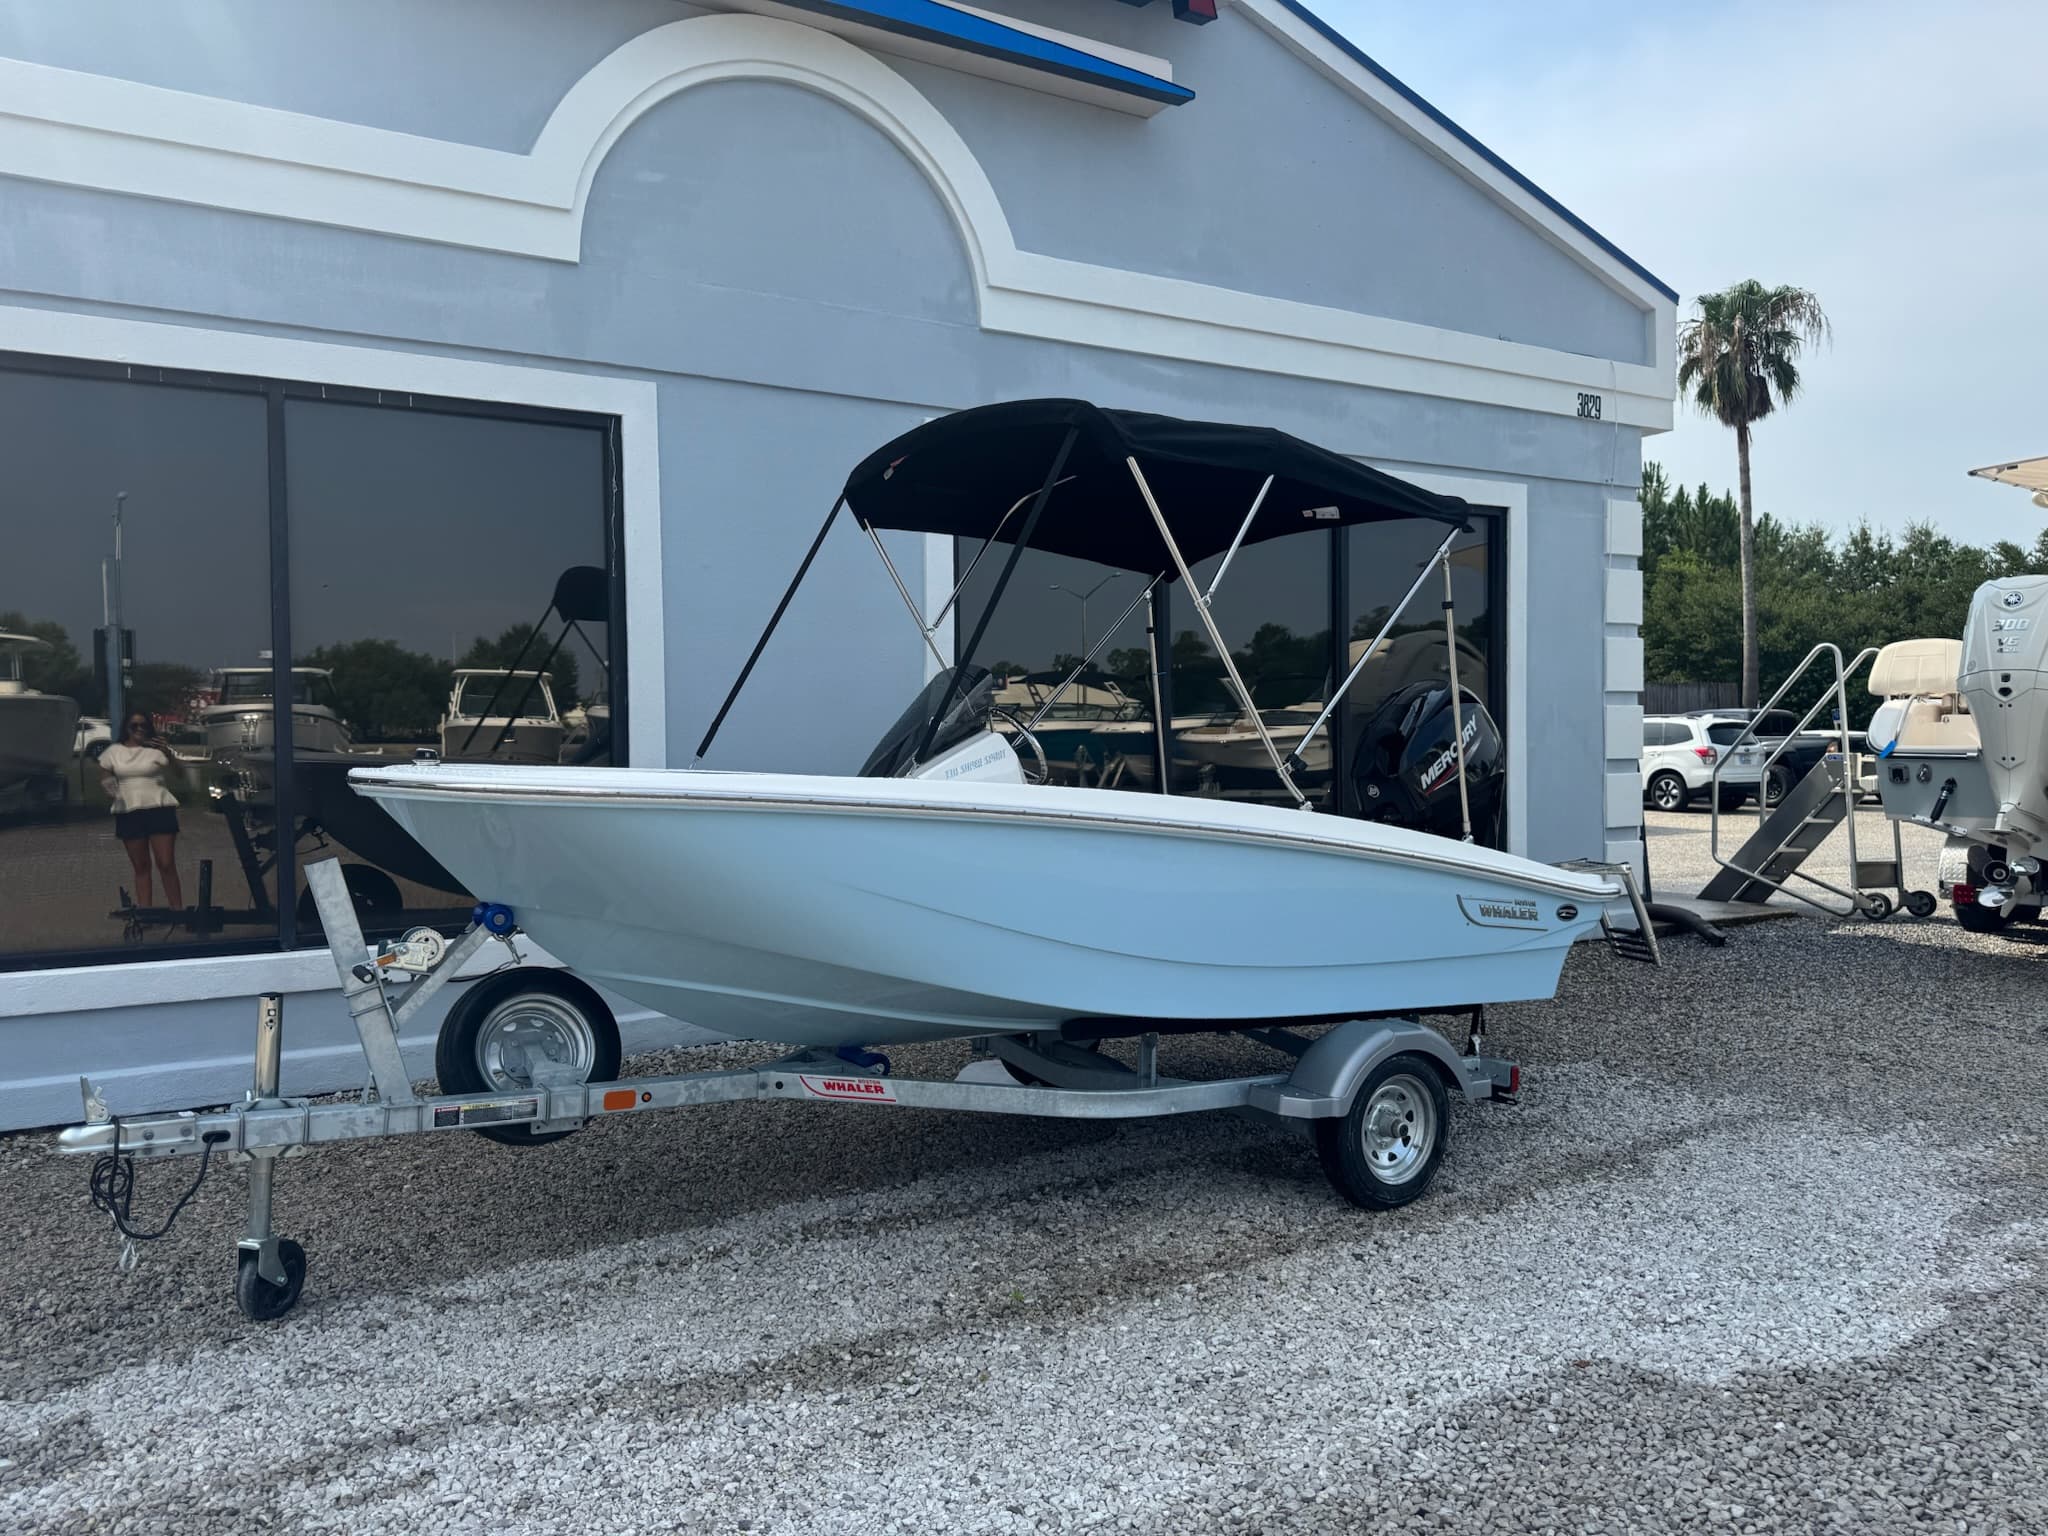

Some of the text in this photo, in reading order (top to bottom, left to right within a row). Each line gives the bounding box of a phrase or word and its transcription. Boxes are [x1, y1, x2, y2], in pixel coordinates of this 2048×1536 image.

[1577, 392, 1601, 420] 3829
[1992, 618, 2030, 632] 300
[1420, 713, 1478, 790] MERCURY
[1479, 904, 1538, 920] WHALER
[823, 1081, 885, 1095] WHALER
